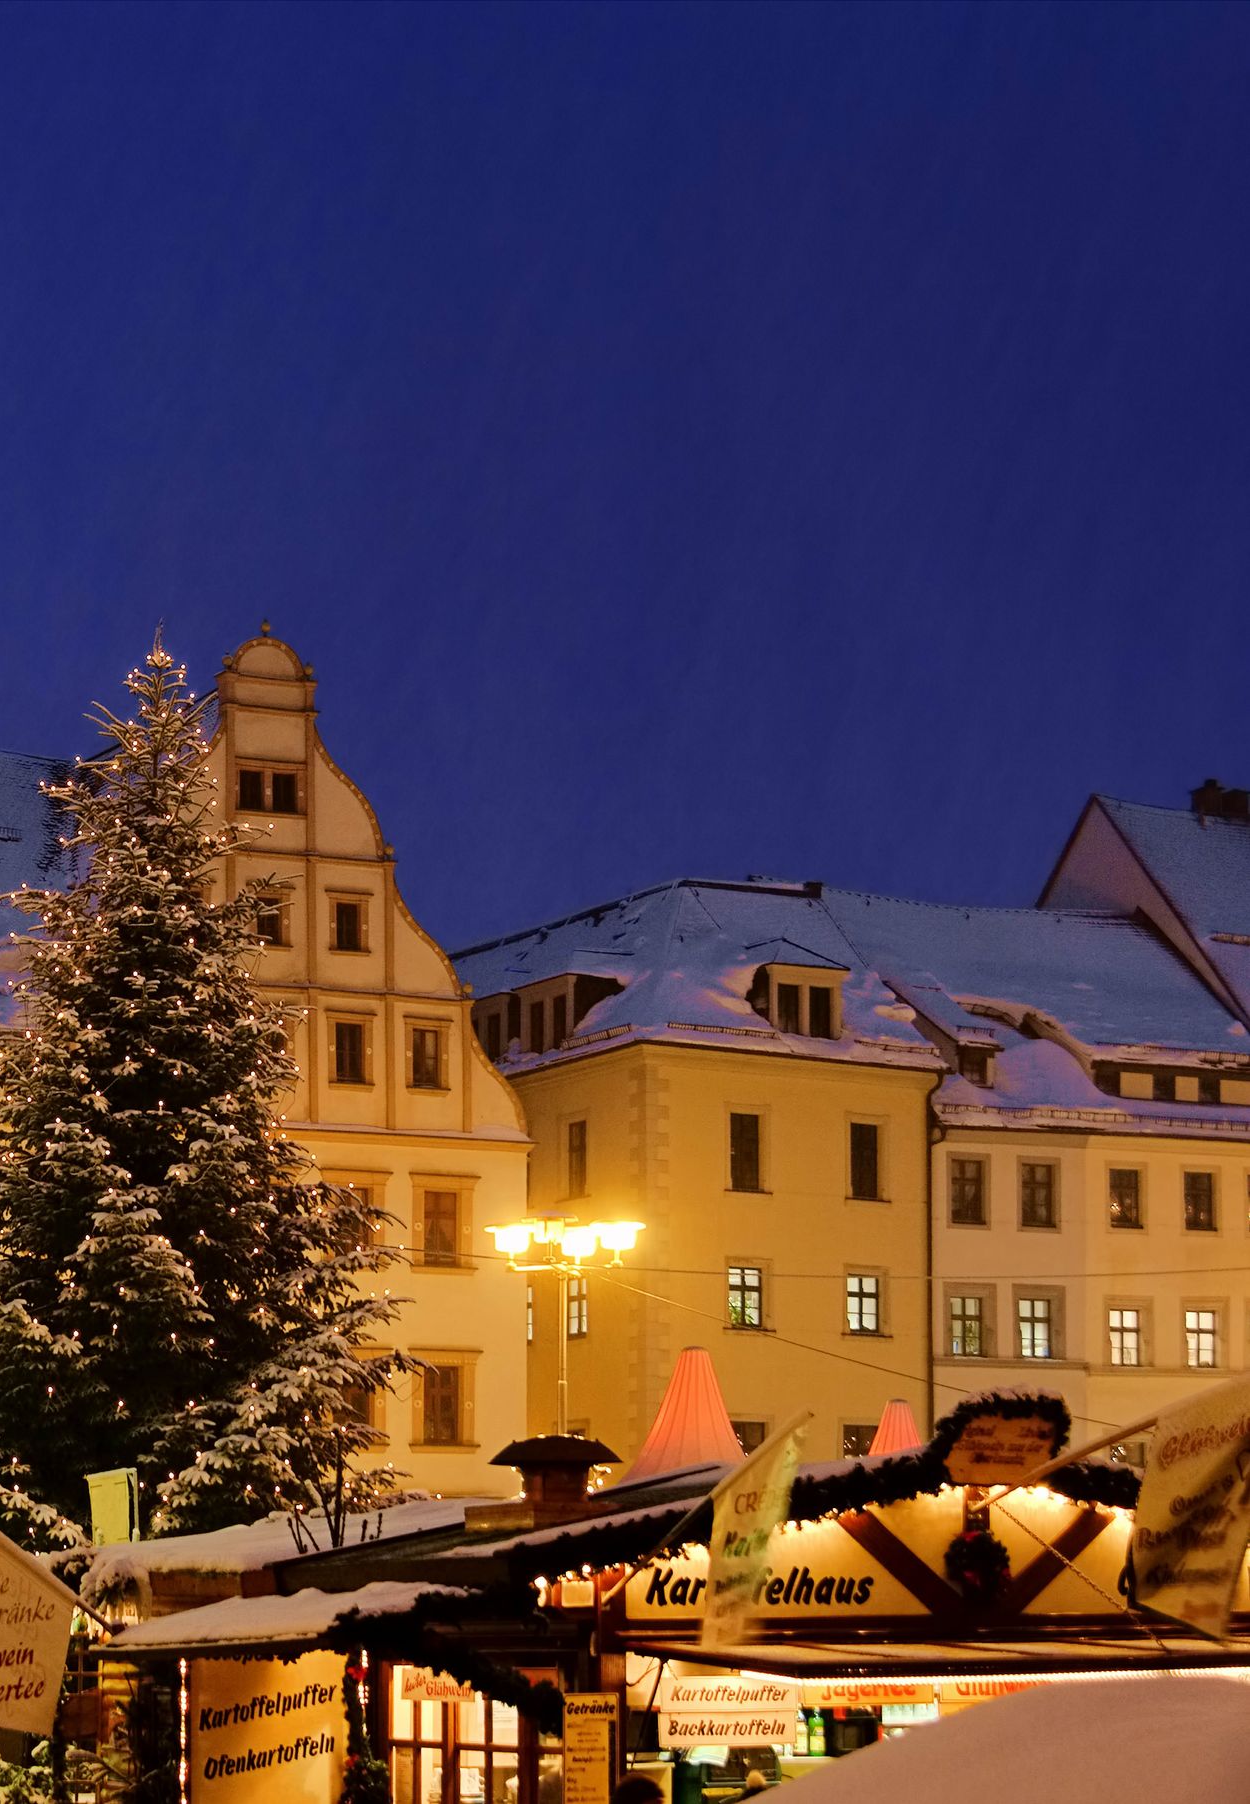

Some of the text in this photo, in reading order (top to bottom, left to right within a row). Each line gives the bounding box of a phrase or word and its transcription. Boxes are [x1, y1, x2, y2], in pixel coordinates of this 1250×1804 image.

[645, 1566, 874, 1607] Karfelhaus
[199, 1683, 338, 1731] Kartoffelpuffer
[566, 1700, 616, 1715] Getränke
[670, 1685, 789, 1704] Kartoffelpuffer
[668, 1719, 786, 1736] Backkartoffeln
[204, 1733, 335, 1780] Ofenkartoffeln
